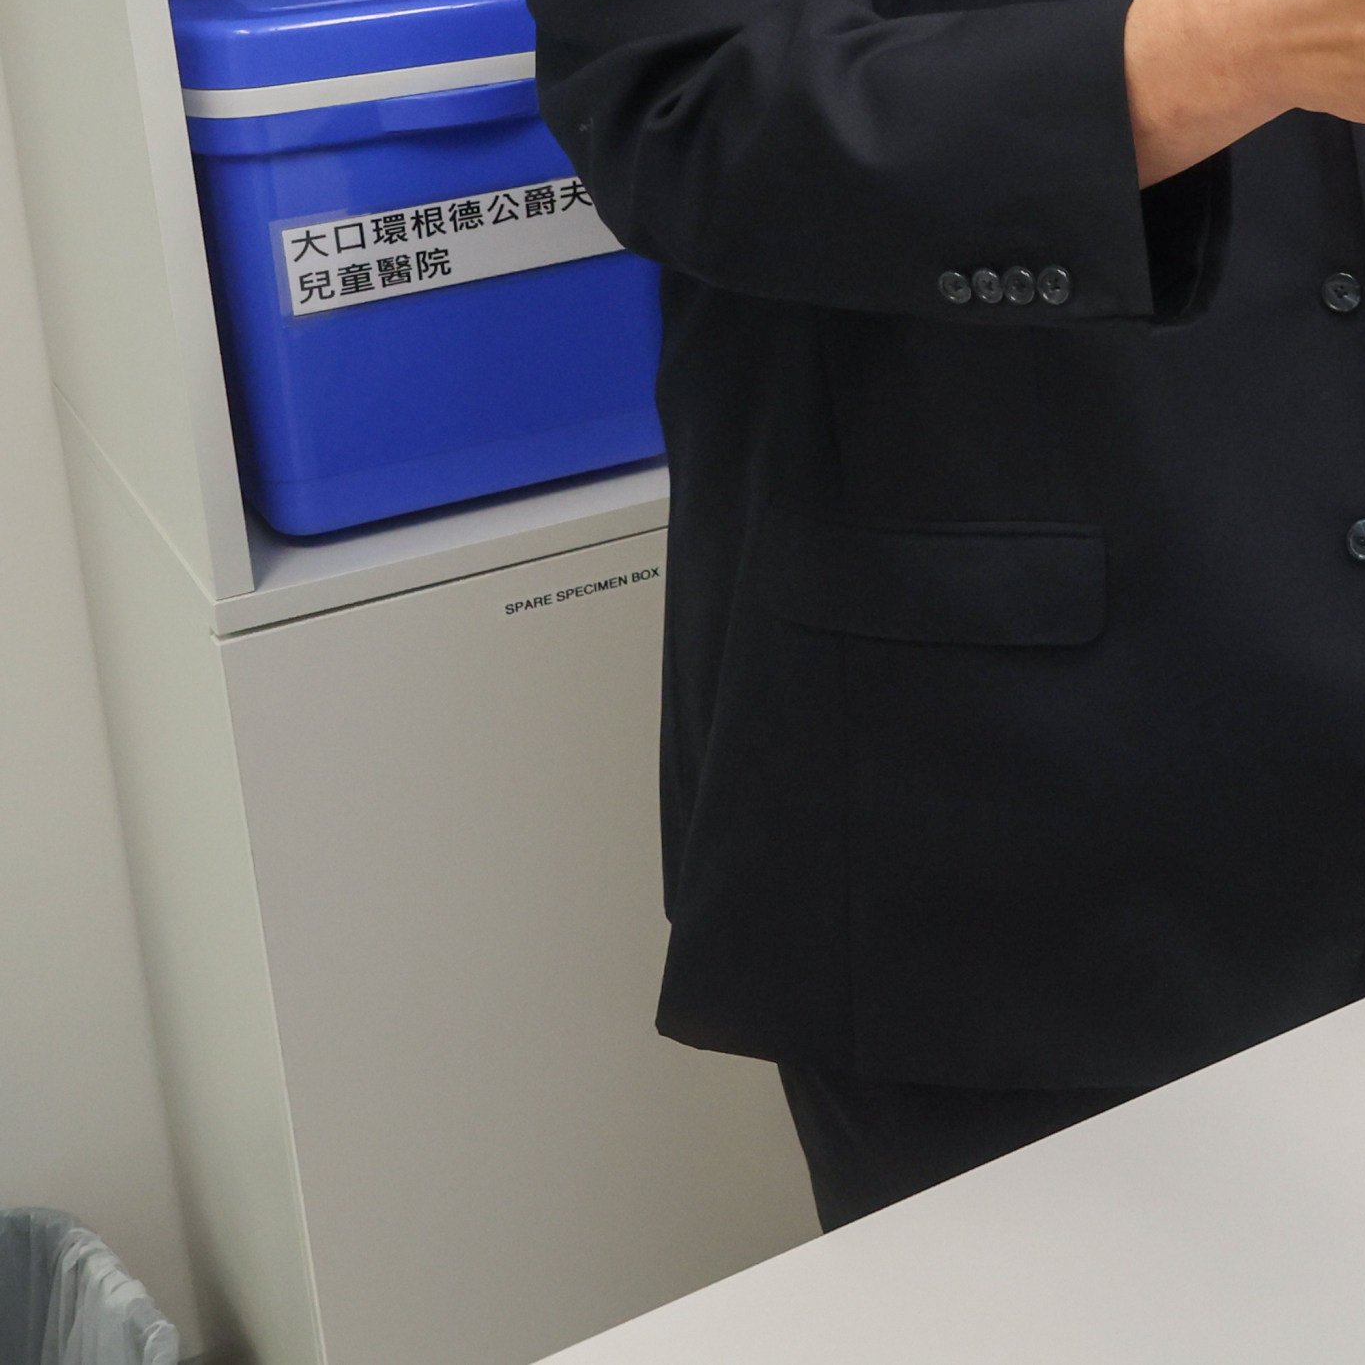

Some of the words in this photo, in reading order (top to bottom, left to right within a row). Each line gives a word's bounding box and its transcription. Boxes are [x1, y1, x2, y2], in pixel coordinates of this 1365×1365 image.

[291, 180, 593, 263] 大口環根德公爵夫
[298, 246, 452, 304] 兒童醫院
[505, 594, 553, 615] SPARE
[556, 575, 628, 603] SPECIMEN
[631, 567, 660, 584] BOX
